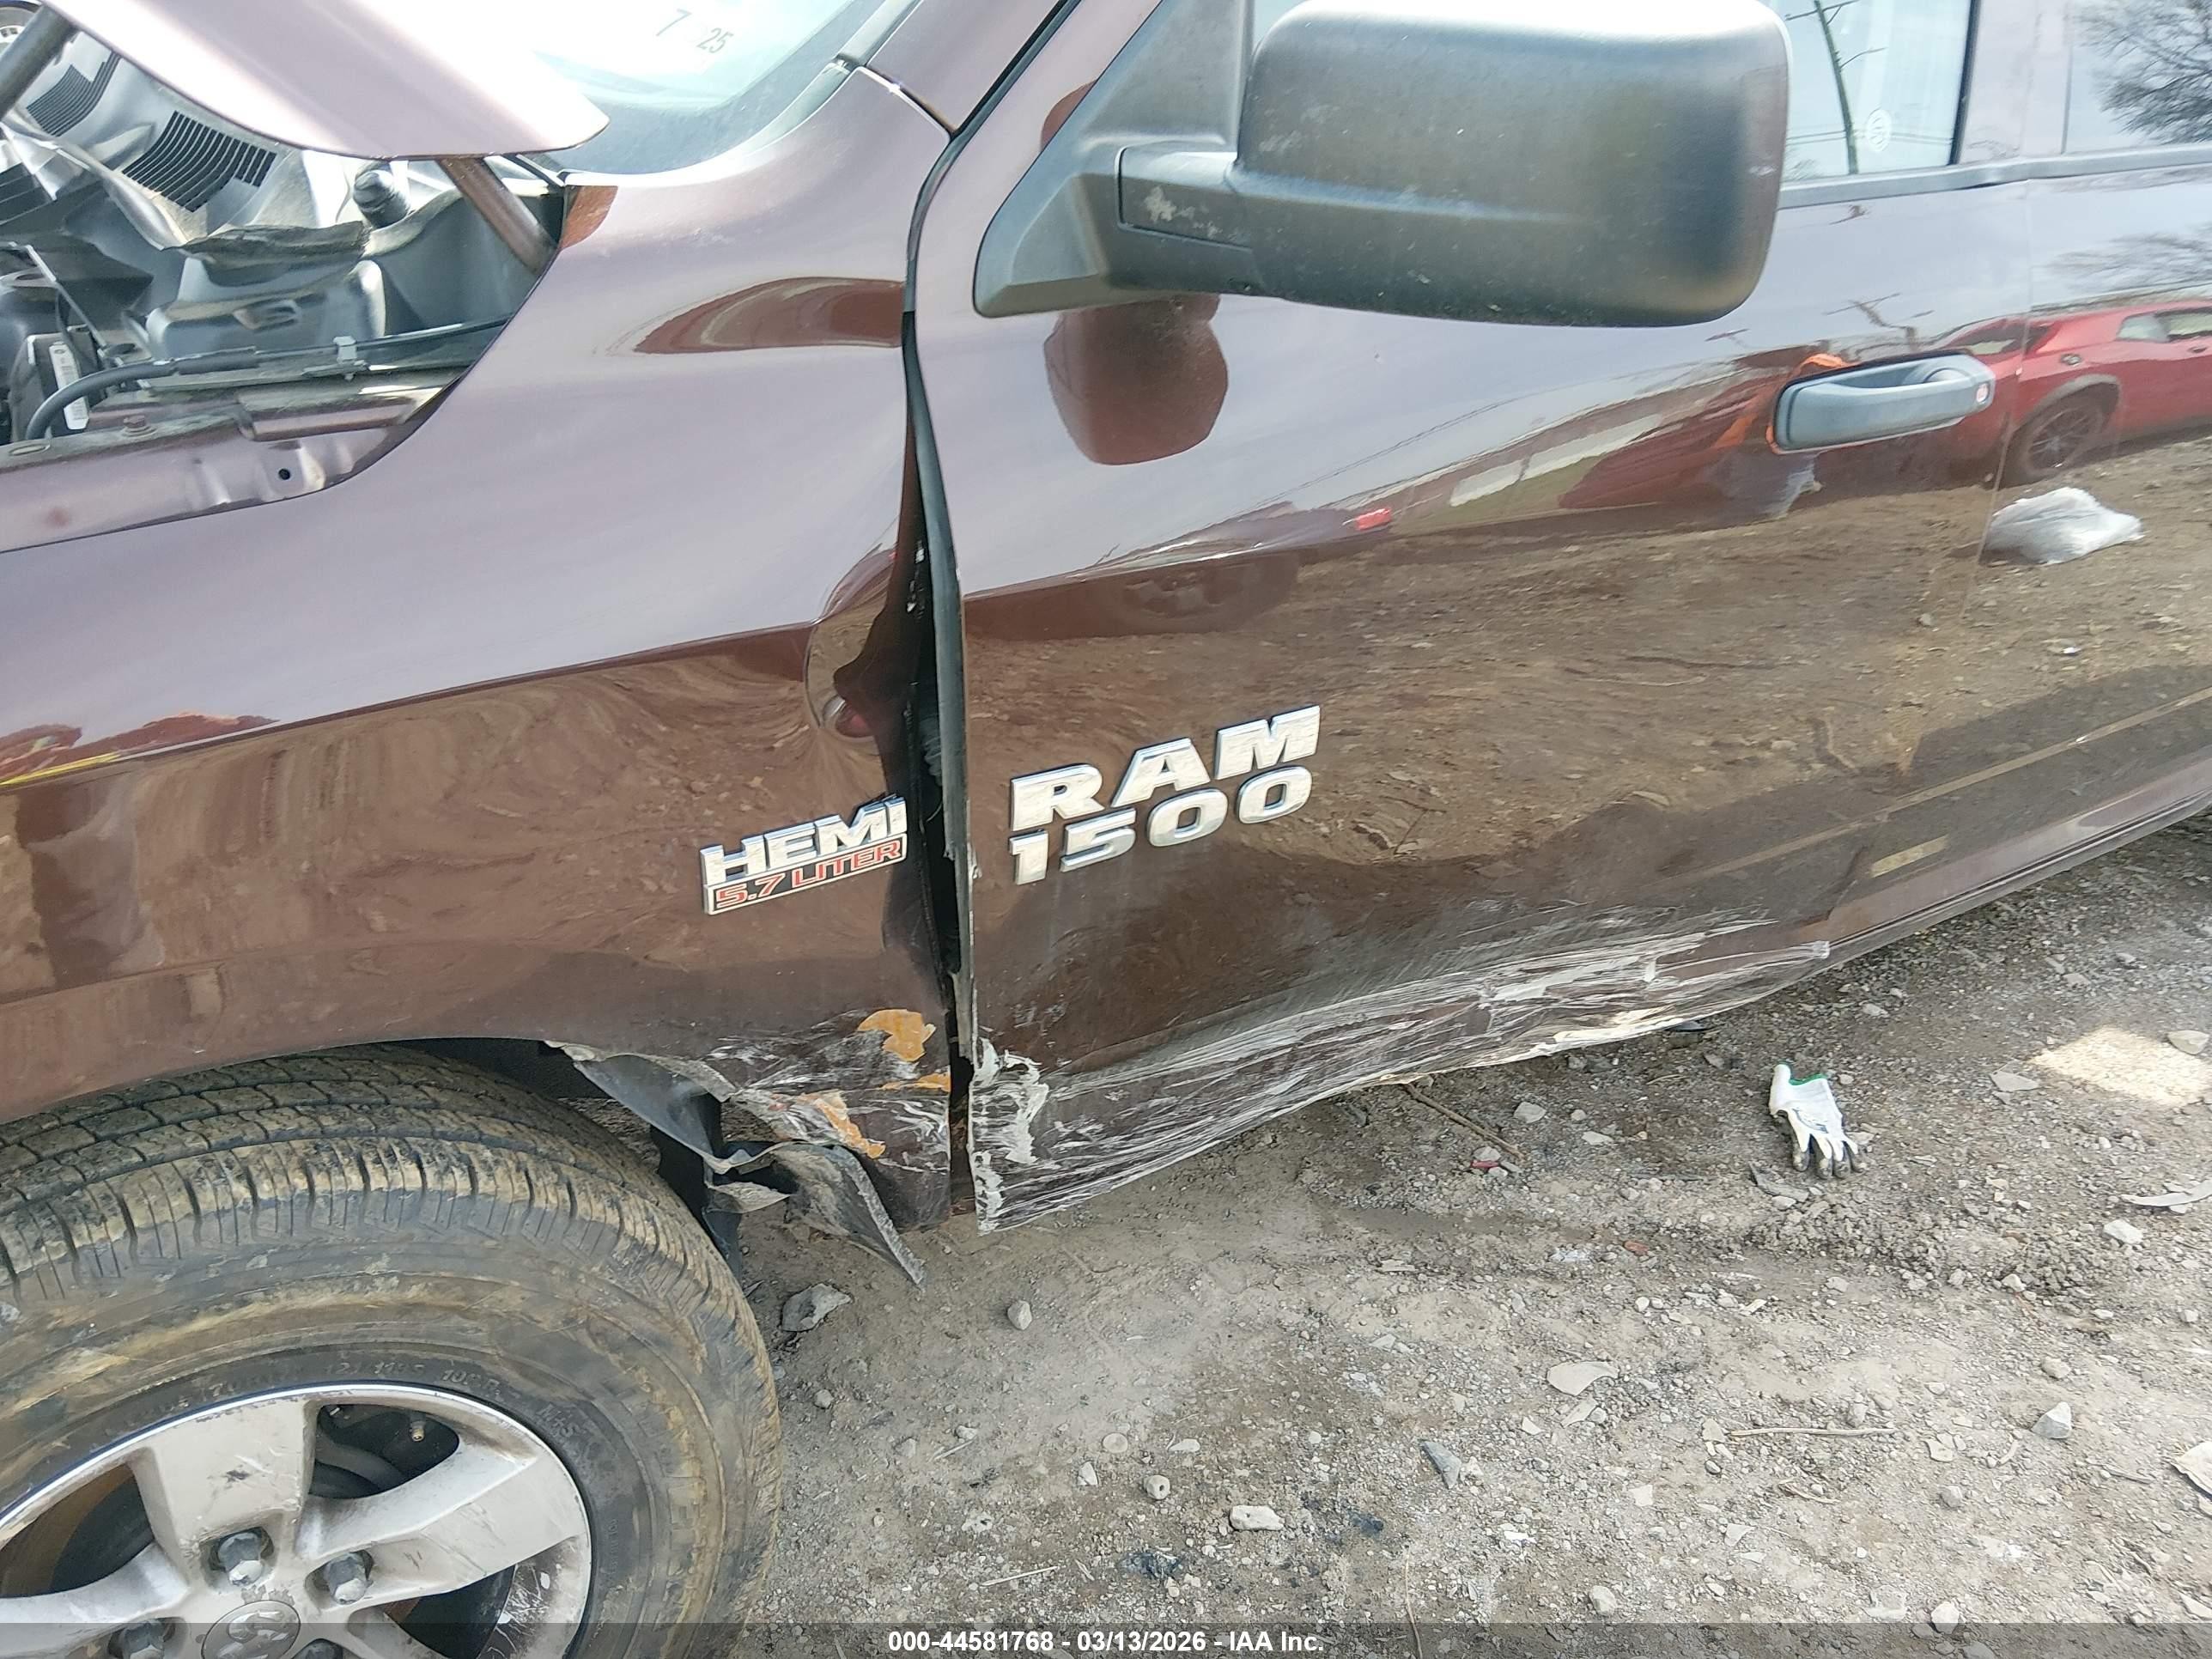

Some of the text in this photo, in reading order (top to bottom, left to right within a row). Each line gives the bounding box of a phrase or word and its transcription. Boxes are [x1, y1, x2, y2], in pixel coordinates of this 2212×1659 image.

[655, 8, 734, 54] 7 25
[1010, 704, 1322, 832] RAM
[700, 796, 908, 886] HEMI
[1009, 764, 1314, 885] 1500
[716, 839, 902, 909] 5.7 LITER
